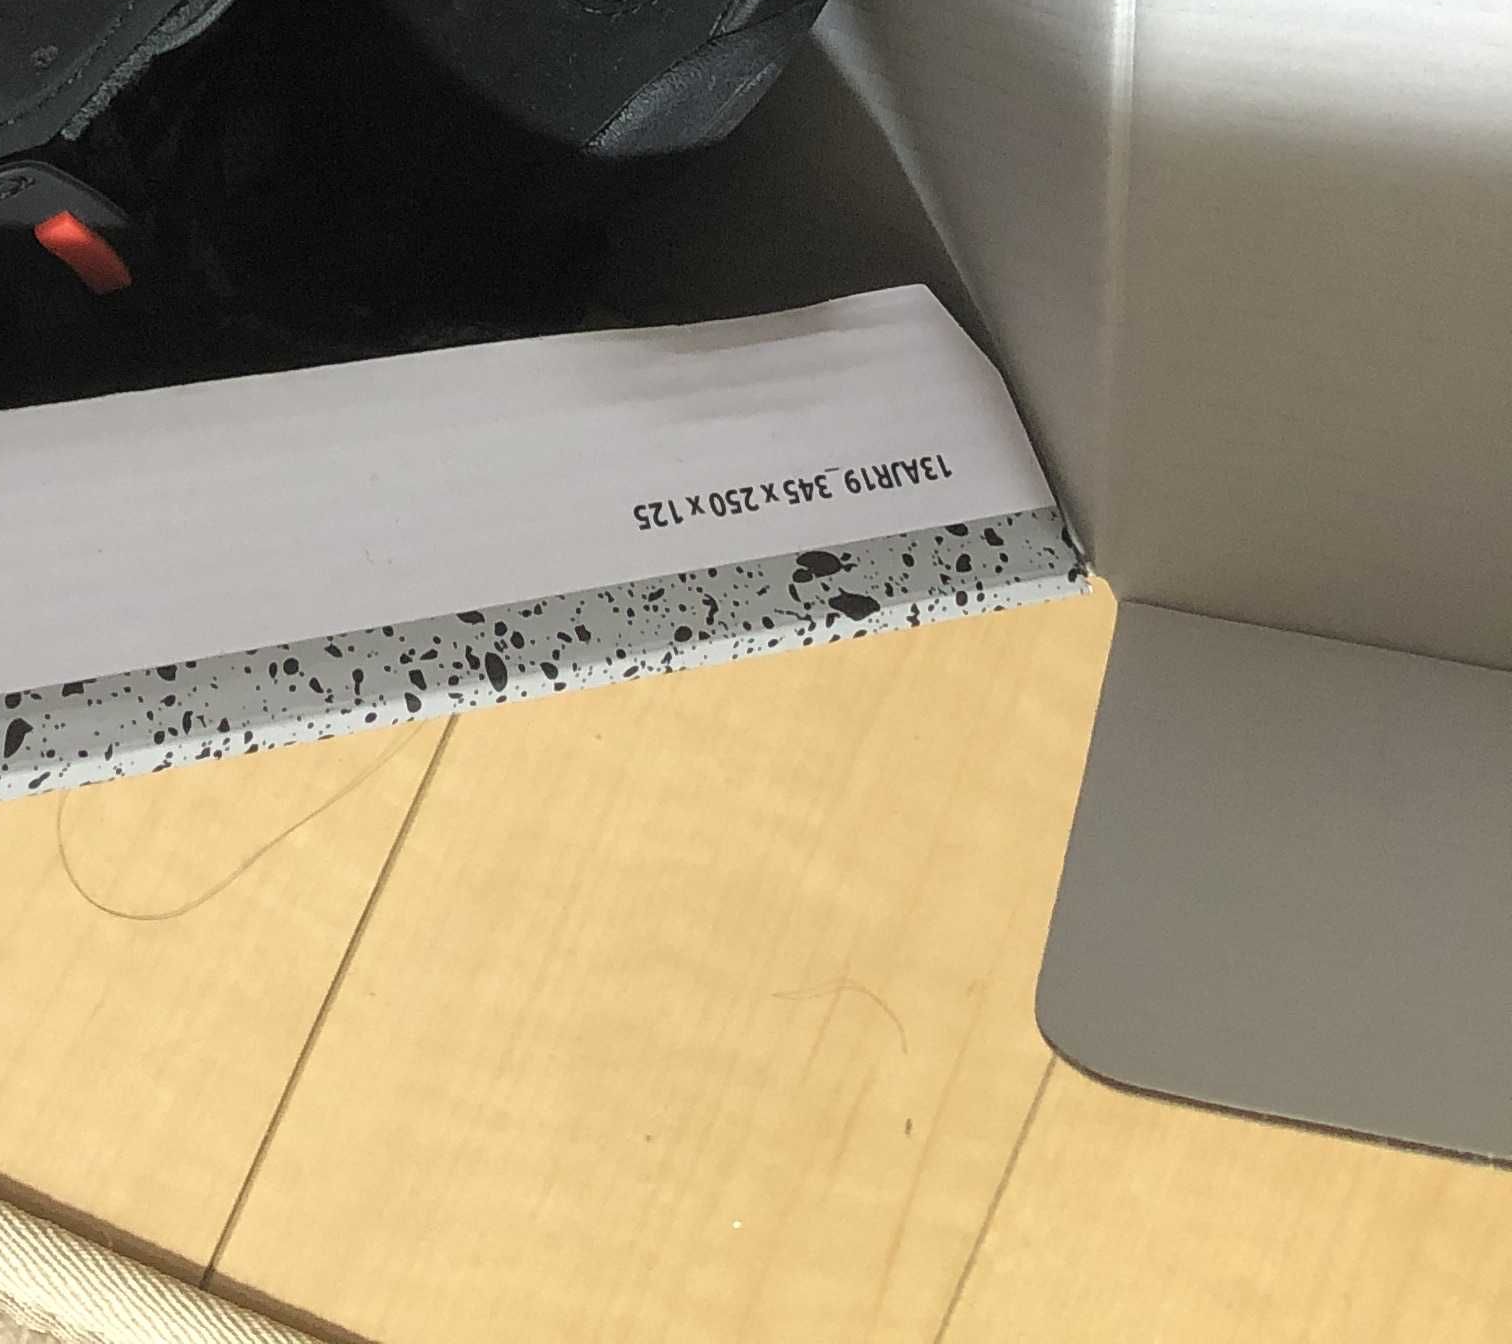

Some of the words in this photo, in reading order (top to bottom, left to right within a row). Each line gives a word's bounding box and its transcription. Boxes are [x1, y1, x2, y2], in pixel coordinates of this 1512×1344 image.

[761, 483, 780, 504] x
[783, 454, 953, 504] 13AJR19_345
[633, 499, 684, 530] 125
[686, 496, 705, 516] x
[709, 486, 760, 517] 250
